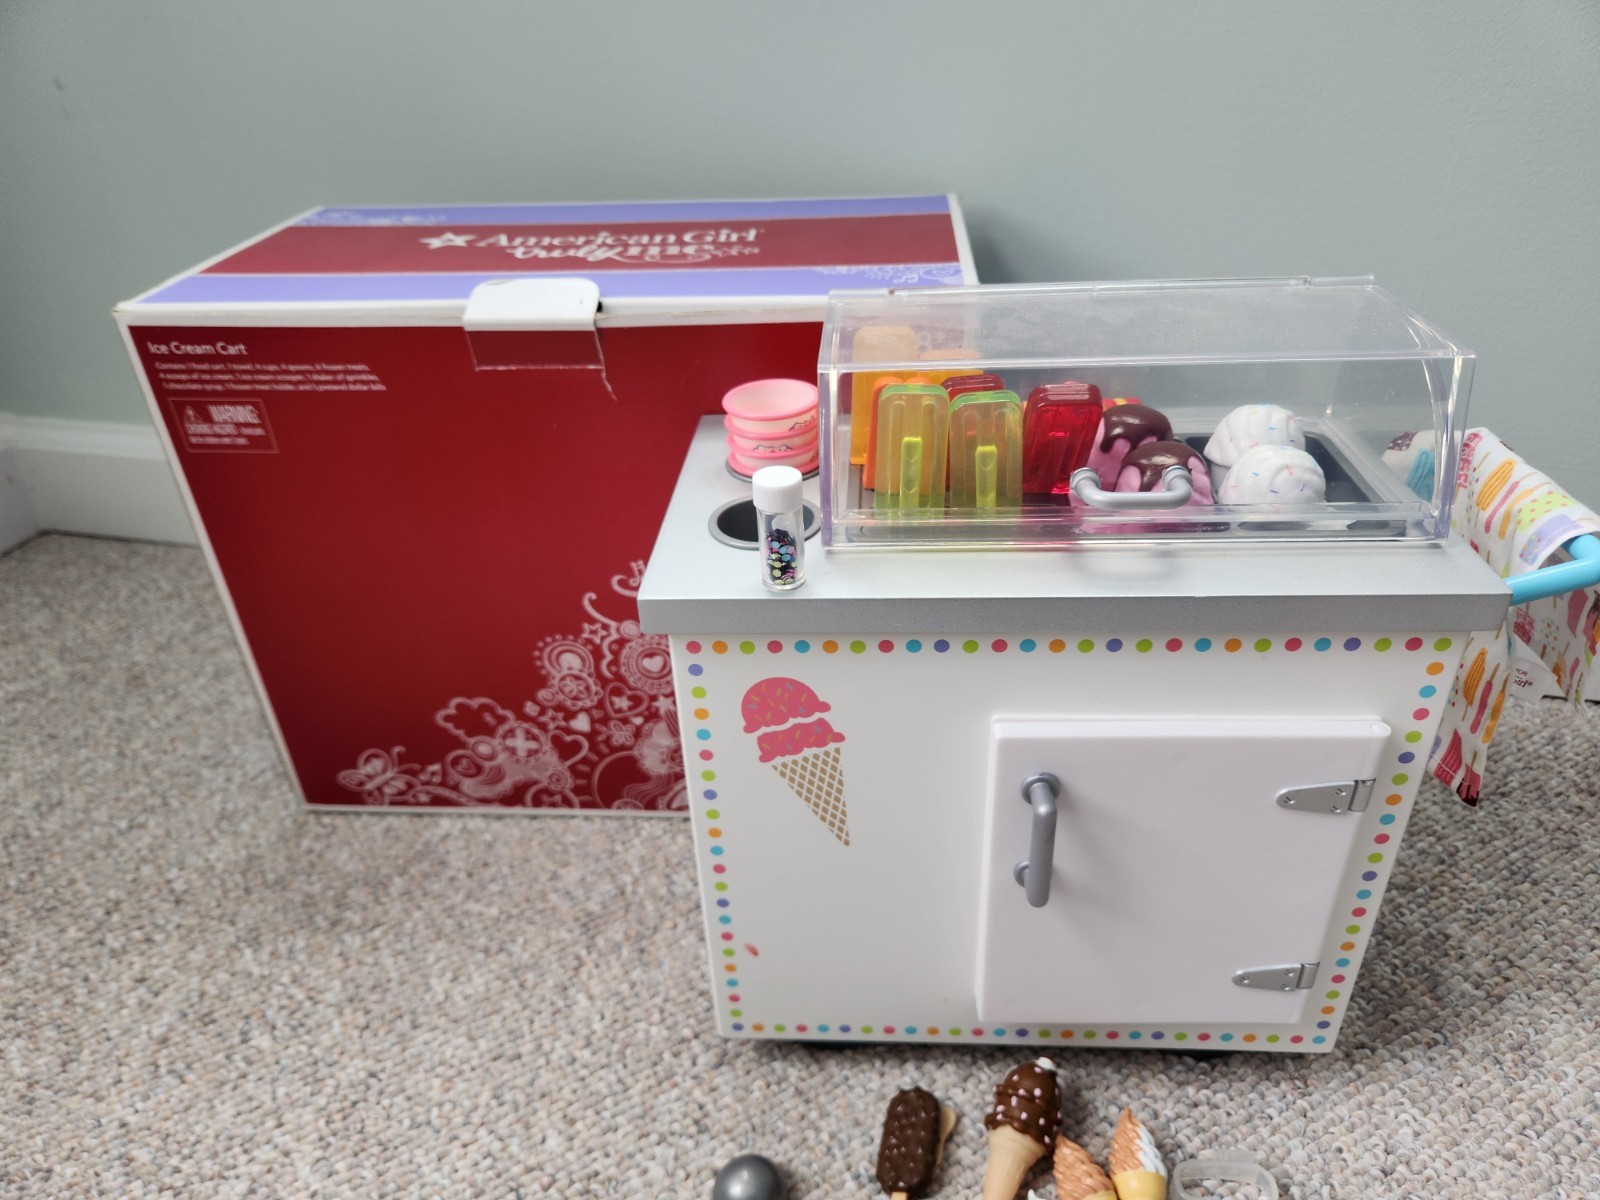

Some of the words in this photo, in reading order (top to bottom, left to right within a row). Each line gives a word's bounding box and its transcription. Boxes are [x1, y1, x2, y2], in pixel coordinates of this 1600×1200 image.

[475, 231, 677, 247] American
[681, 227, 758, 244] Girl
[147, 341, 169, 354] Ice
[169, 341, 216, 355] Cream
[215, 341, 248, 355] Cart
